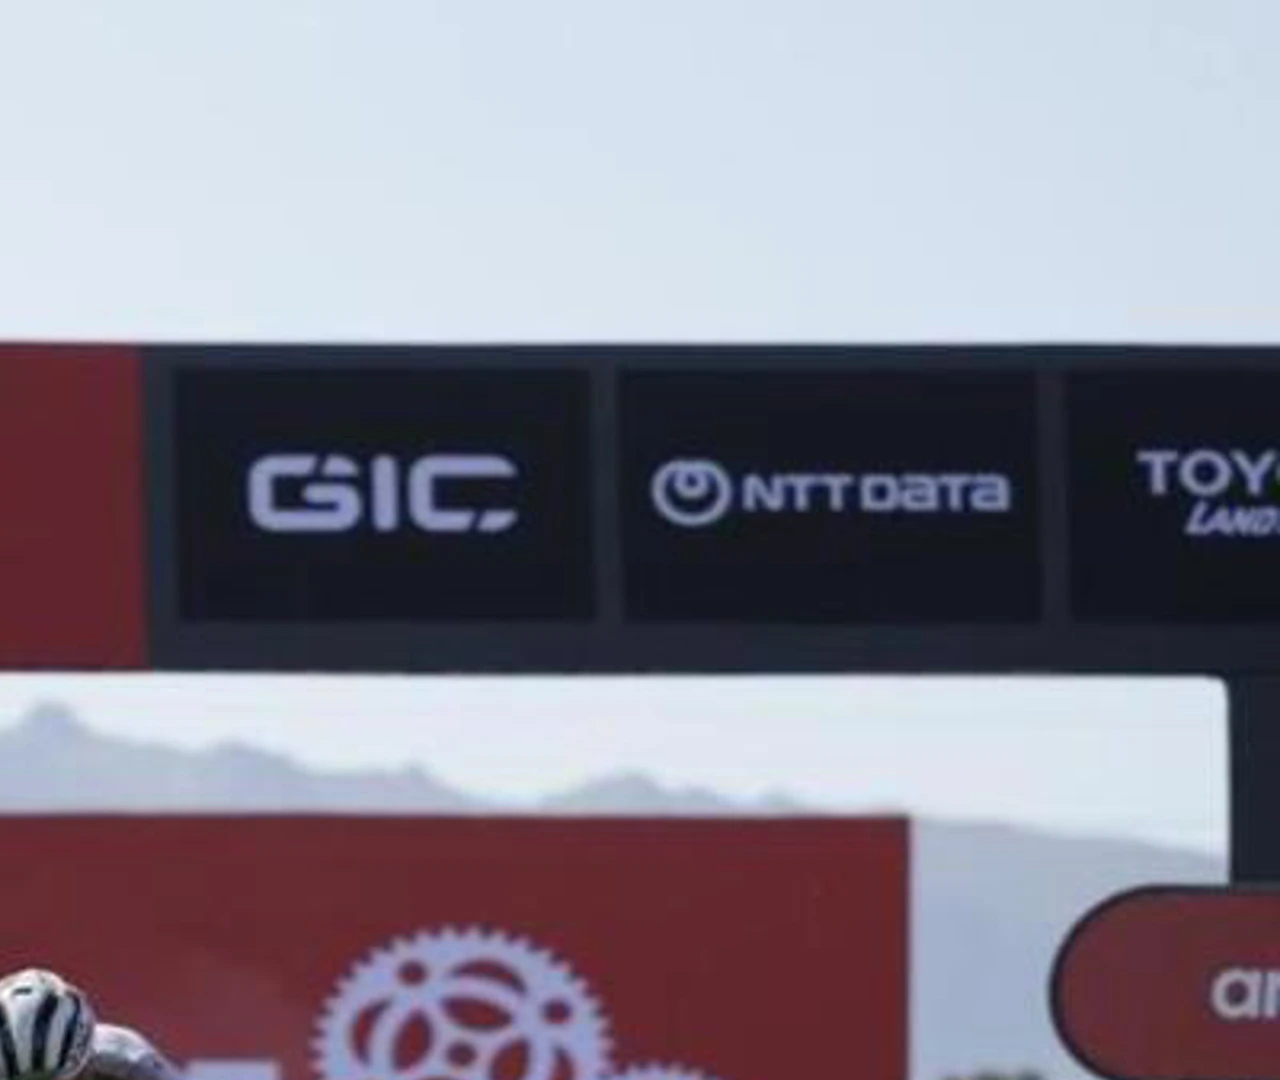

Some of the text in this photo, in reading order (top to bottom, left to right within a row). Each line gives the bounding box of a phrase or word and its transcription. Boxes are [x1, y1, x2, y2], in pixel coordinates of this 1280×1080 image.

[248, 454, 517, 532] GIC
[742, 474, 853, 511] NTT
[1137, 449, 1280, 496] TOY
